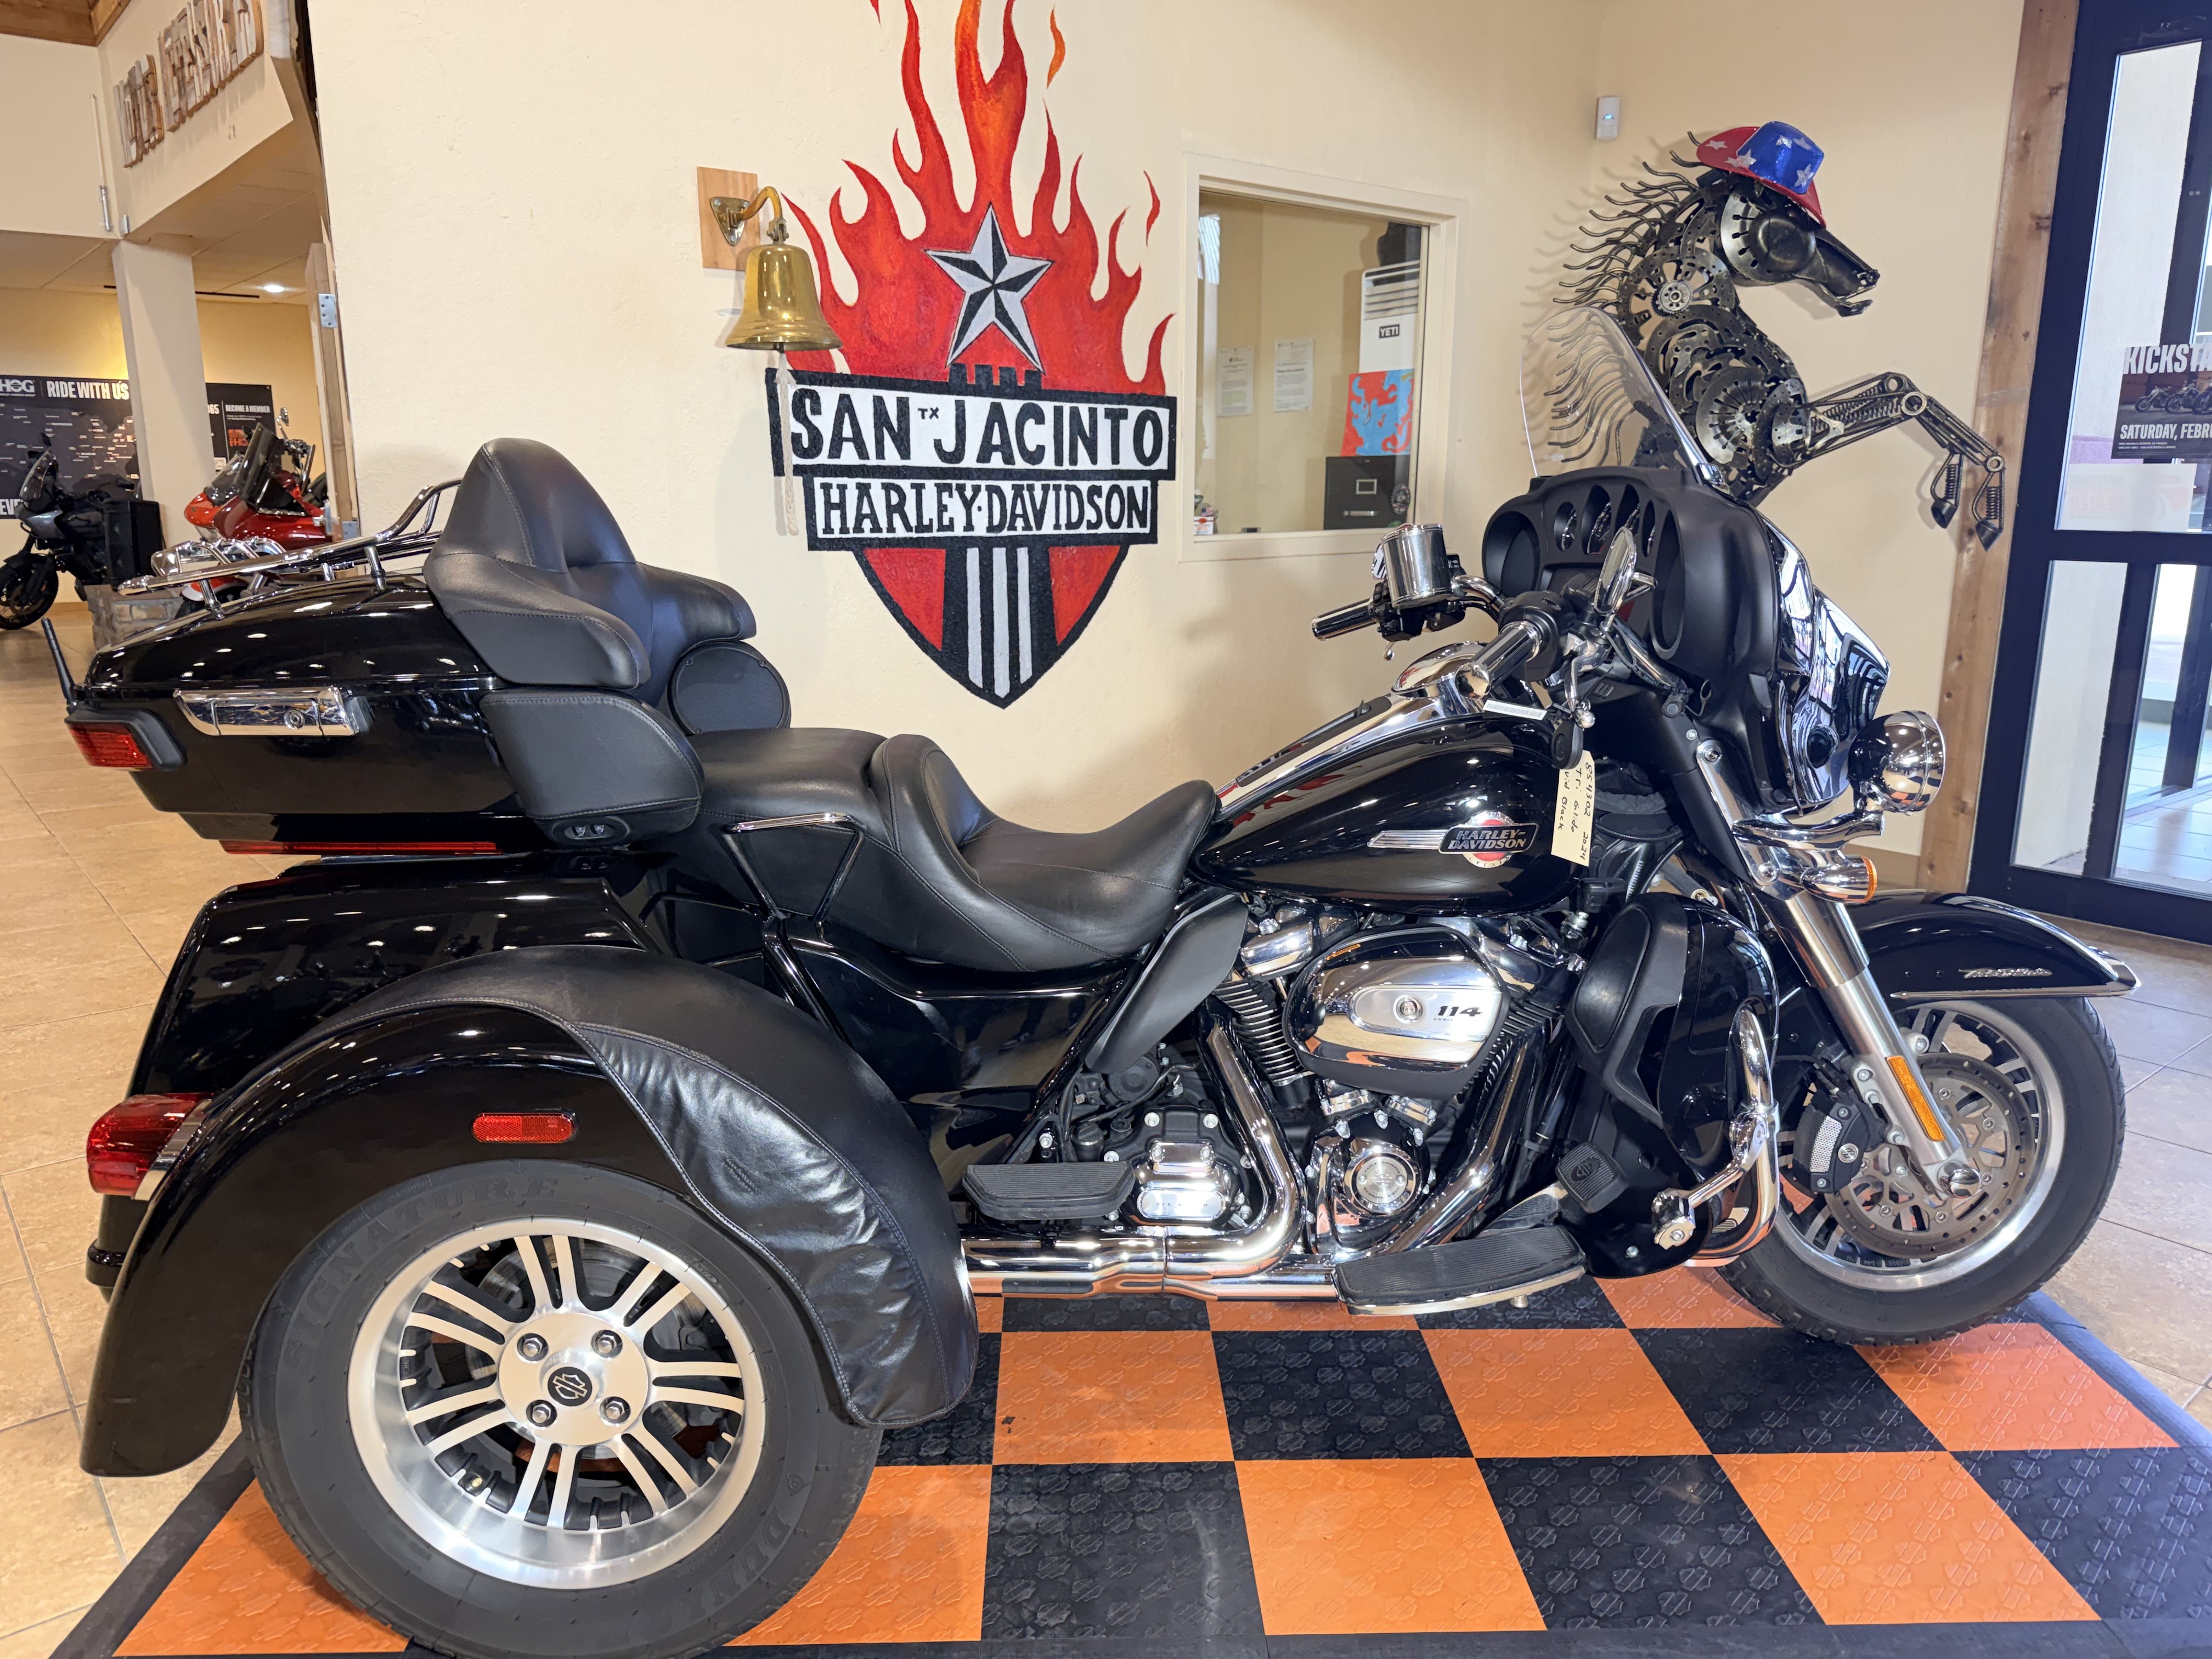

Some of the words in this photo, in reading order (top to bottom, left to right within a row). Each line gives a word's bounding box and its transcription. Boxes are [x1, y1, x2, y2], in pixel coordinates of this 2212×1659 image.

[1380, 327, 1398, 336] YETI
[46, 380, 77, 398] RIDE
[76, 381, 111, 399] WITH
[111, 382, 129, 400] US
[791, 388, 911, 461] SAN
[917, 406, 939, 420] TX
[933, 399, 1164, 468] JACINTO
[2119, 423, 2177, 441] SATURDAY,
[1455, 829, 1526, 840] HARLEY-
[1447, 838, 1527, 850] DAVIDSON
[1579, 831, 1588, 860] 2024
[1437, 1006, 1482, 1017] 114
[283, 1176, 558, 1370] SIGNATURE
